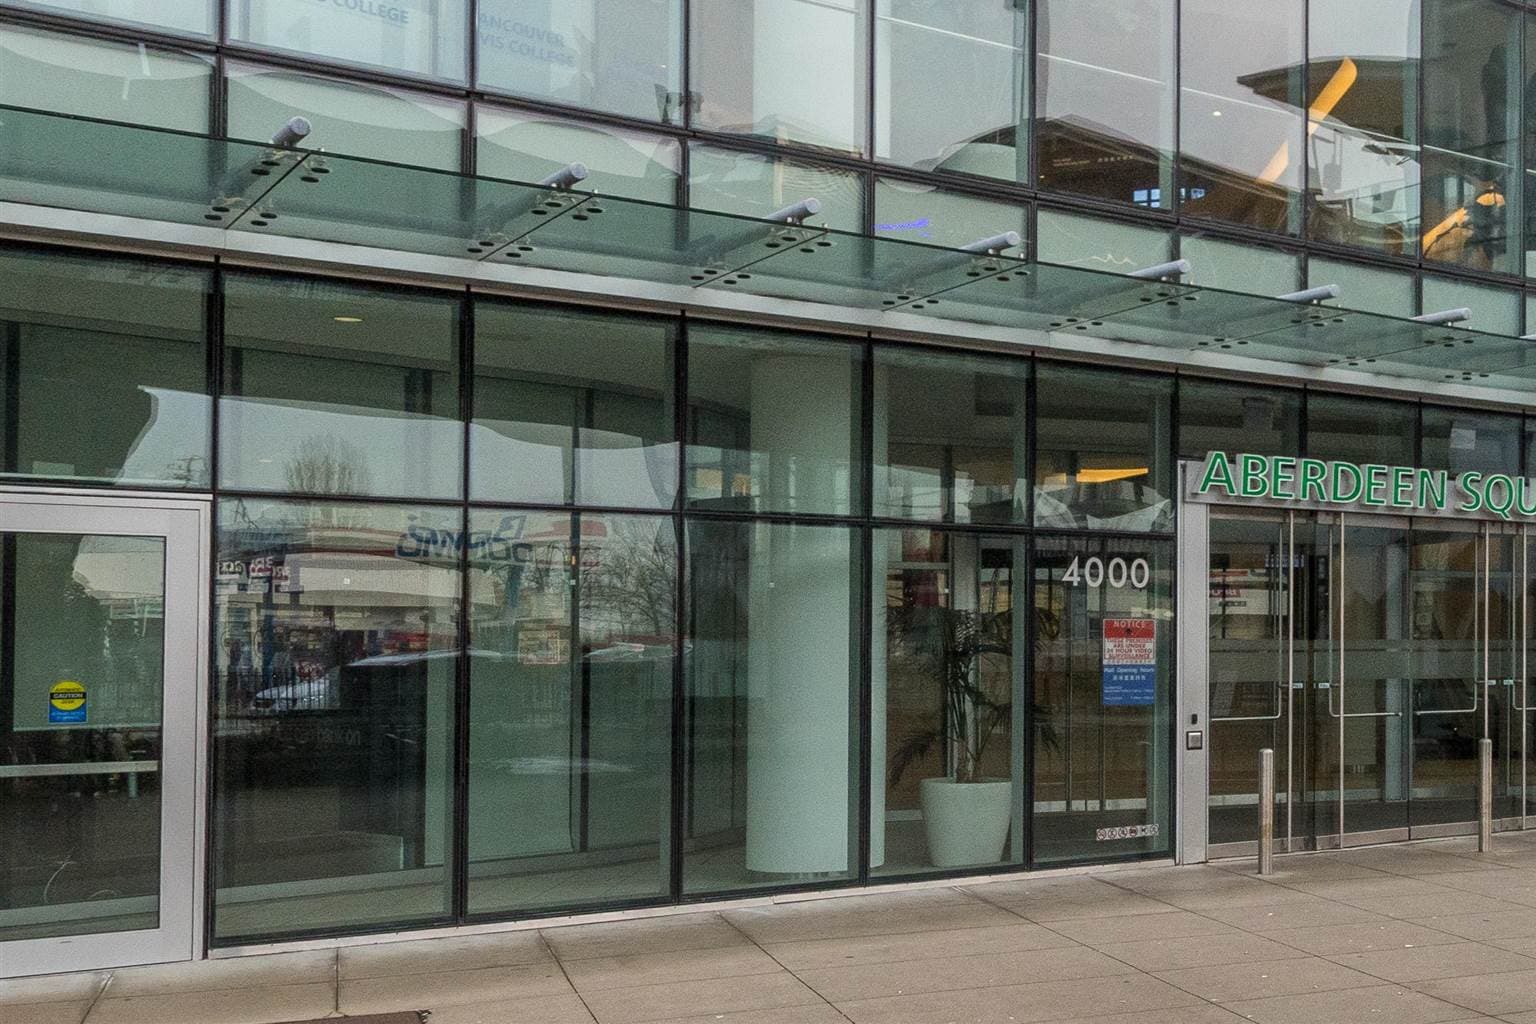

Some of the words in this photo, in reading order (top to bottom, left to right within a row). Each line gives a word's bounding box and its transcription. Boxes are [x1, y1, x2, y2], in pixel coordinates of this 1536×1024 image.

[479, 12, 566, 47] ANCOUVER
[1199, 450, 1447, 509] ABERDEEN
[1062, 555, 1149, 588] 4000
